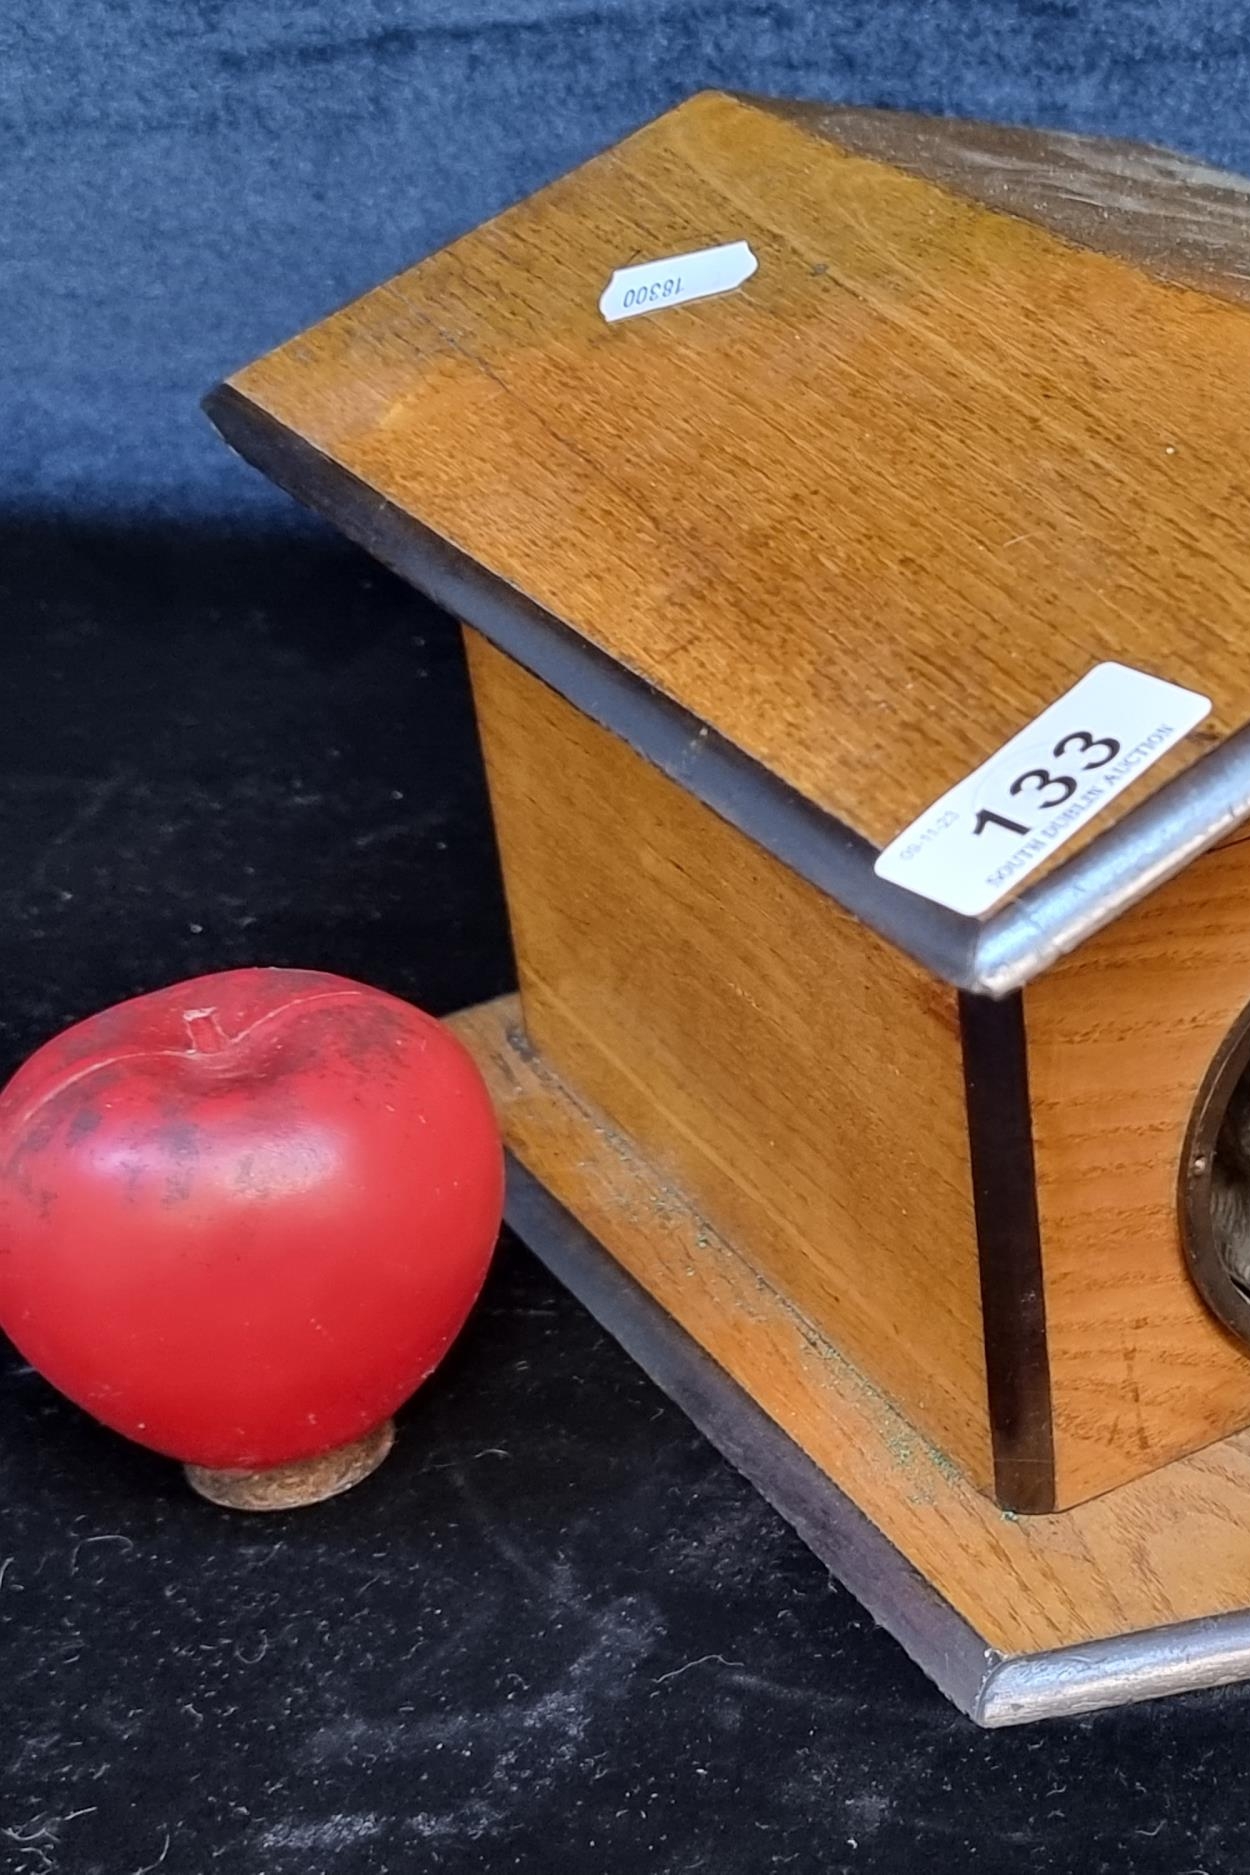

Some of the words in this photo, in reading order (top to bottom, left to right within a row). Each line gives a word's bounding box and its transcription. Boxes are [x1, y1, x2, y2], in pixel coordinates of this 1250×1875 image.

[623, 277, 684, 308] 18300
[972, 731, 1121, 840] 133
[986, 838, 1044, 887] SOUTH
[1043, 785, 1105, 840] DUBLIN
[1105, 724, 1175, 786] AUCTION
